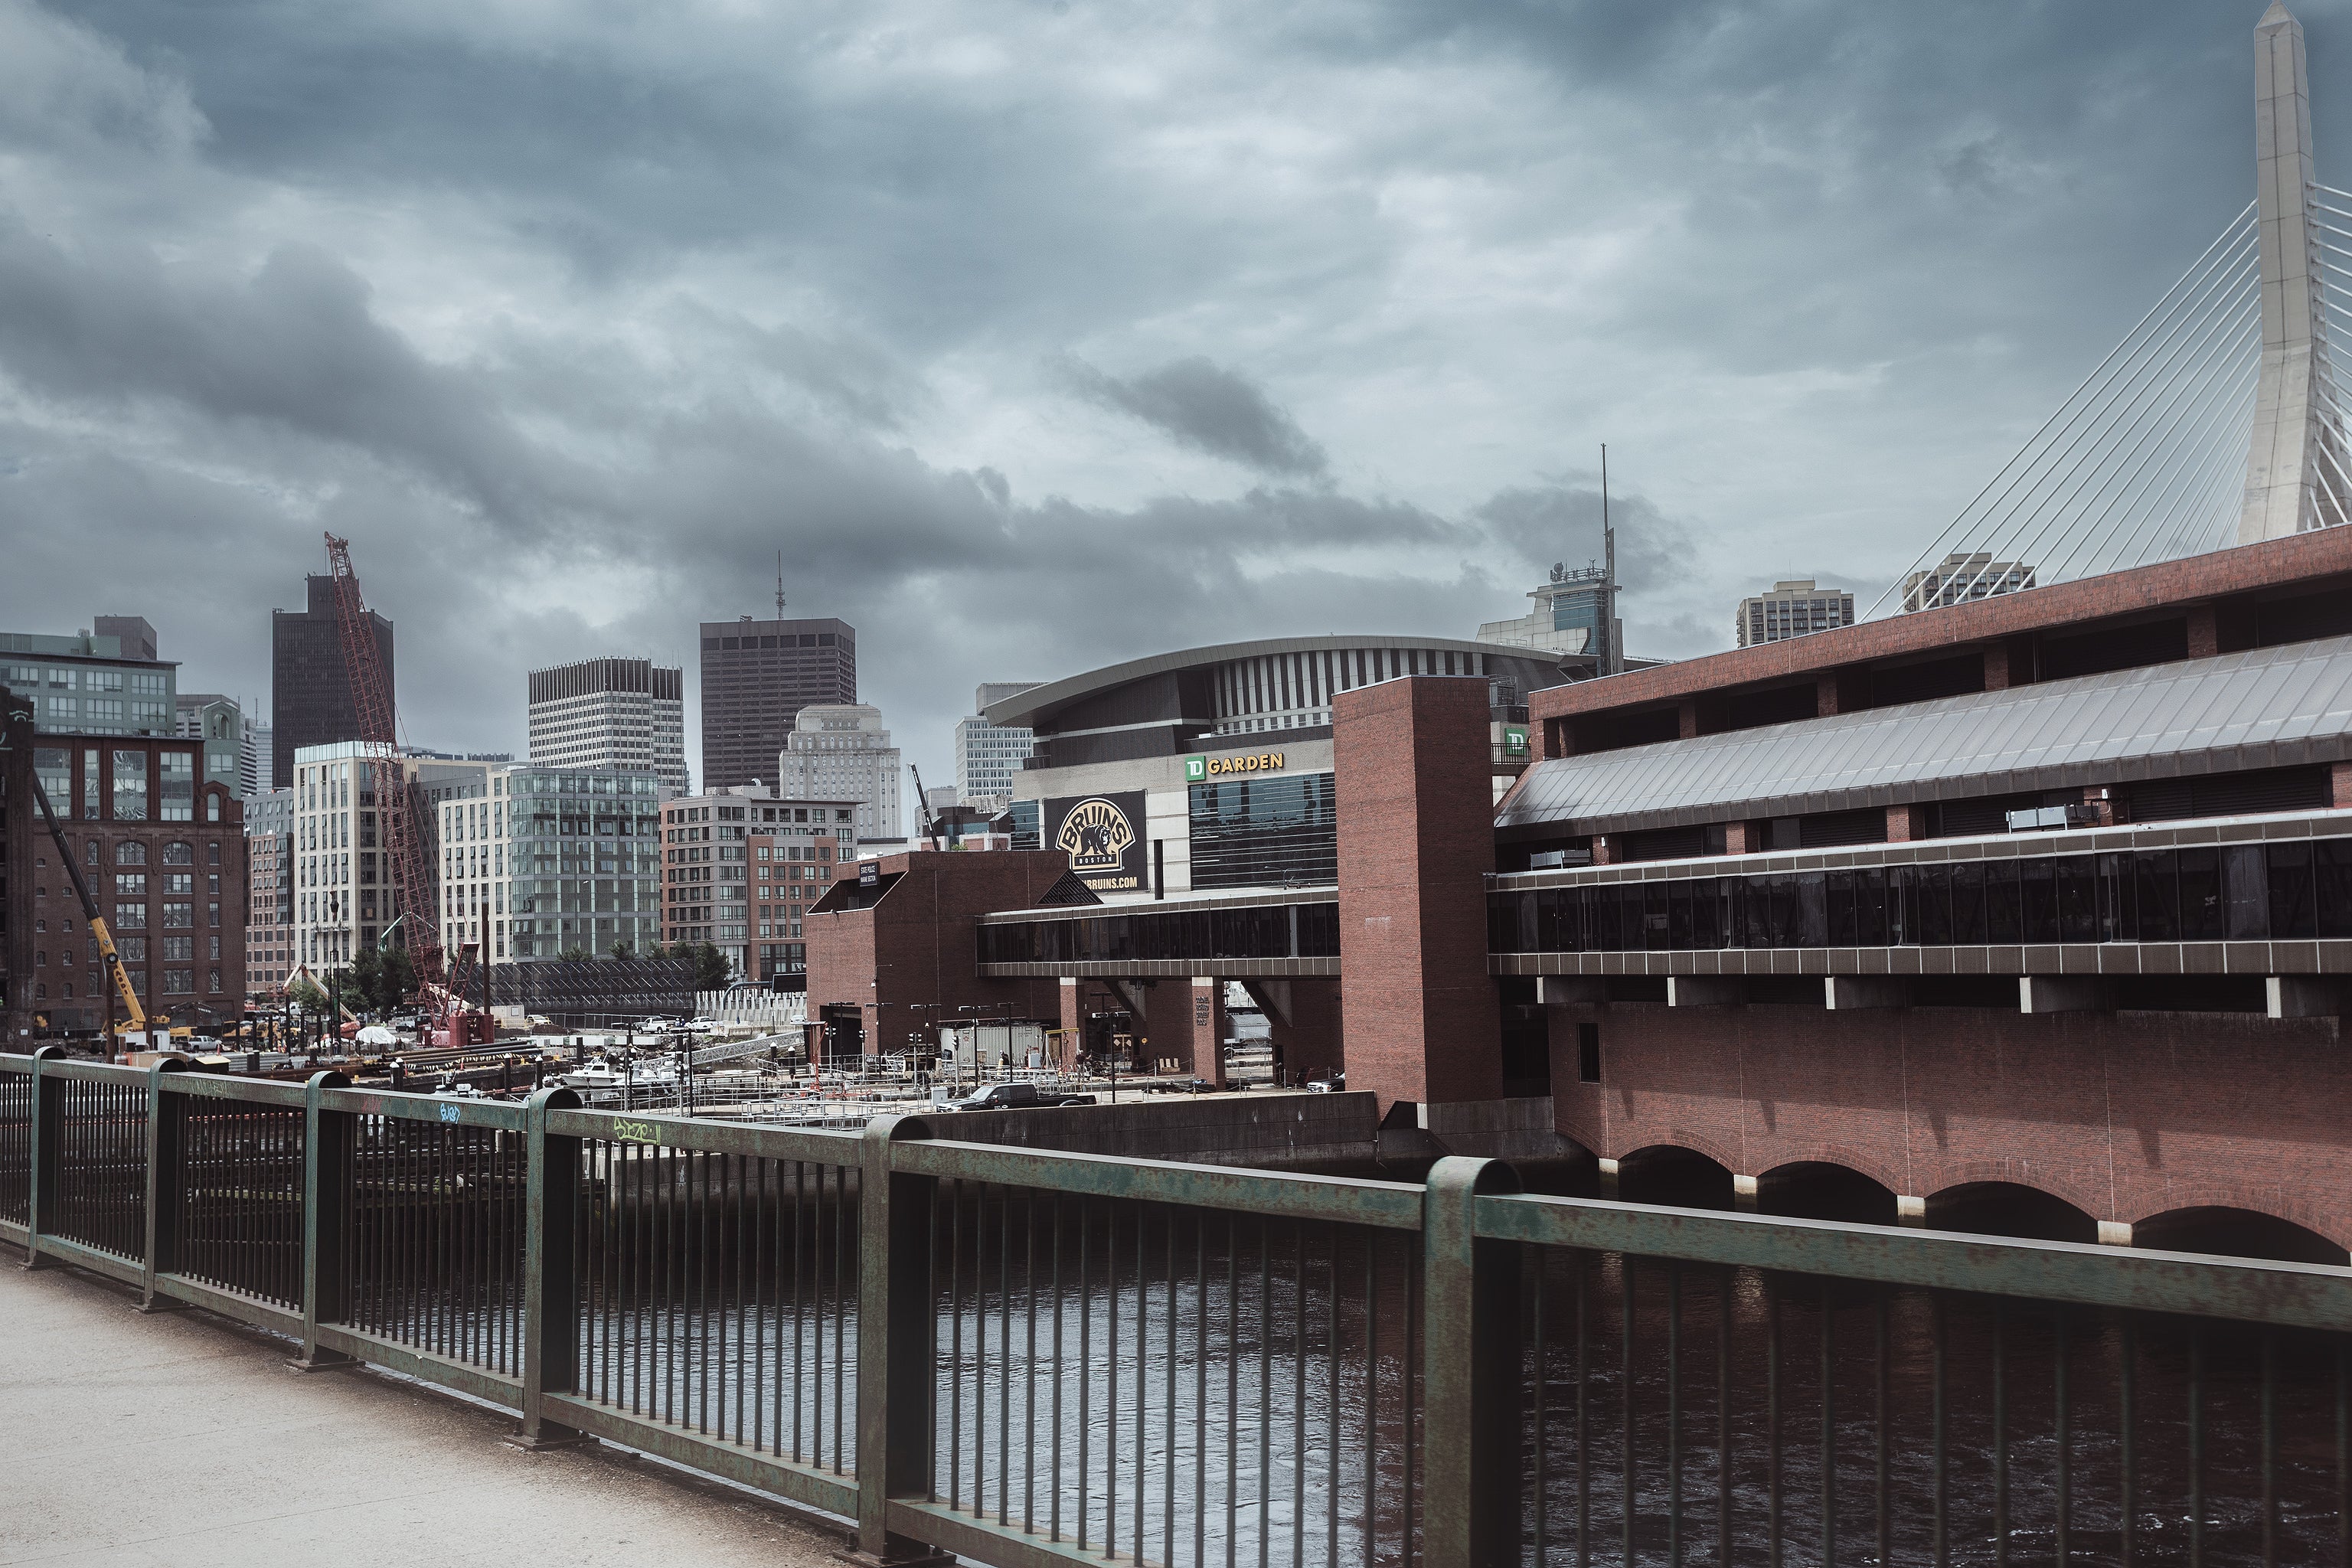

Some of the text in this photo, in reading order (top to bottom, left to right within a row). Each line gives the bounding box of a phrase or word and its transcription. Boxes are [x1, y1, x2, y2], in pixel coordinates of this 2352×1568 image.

[1508, 733, 1524, 750] TD
[1187, 753, 1283, 776] TD GARDEN
[1062, 805, 1127, 849] BRUINS
